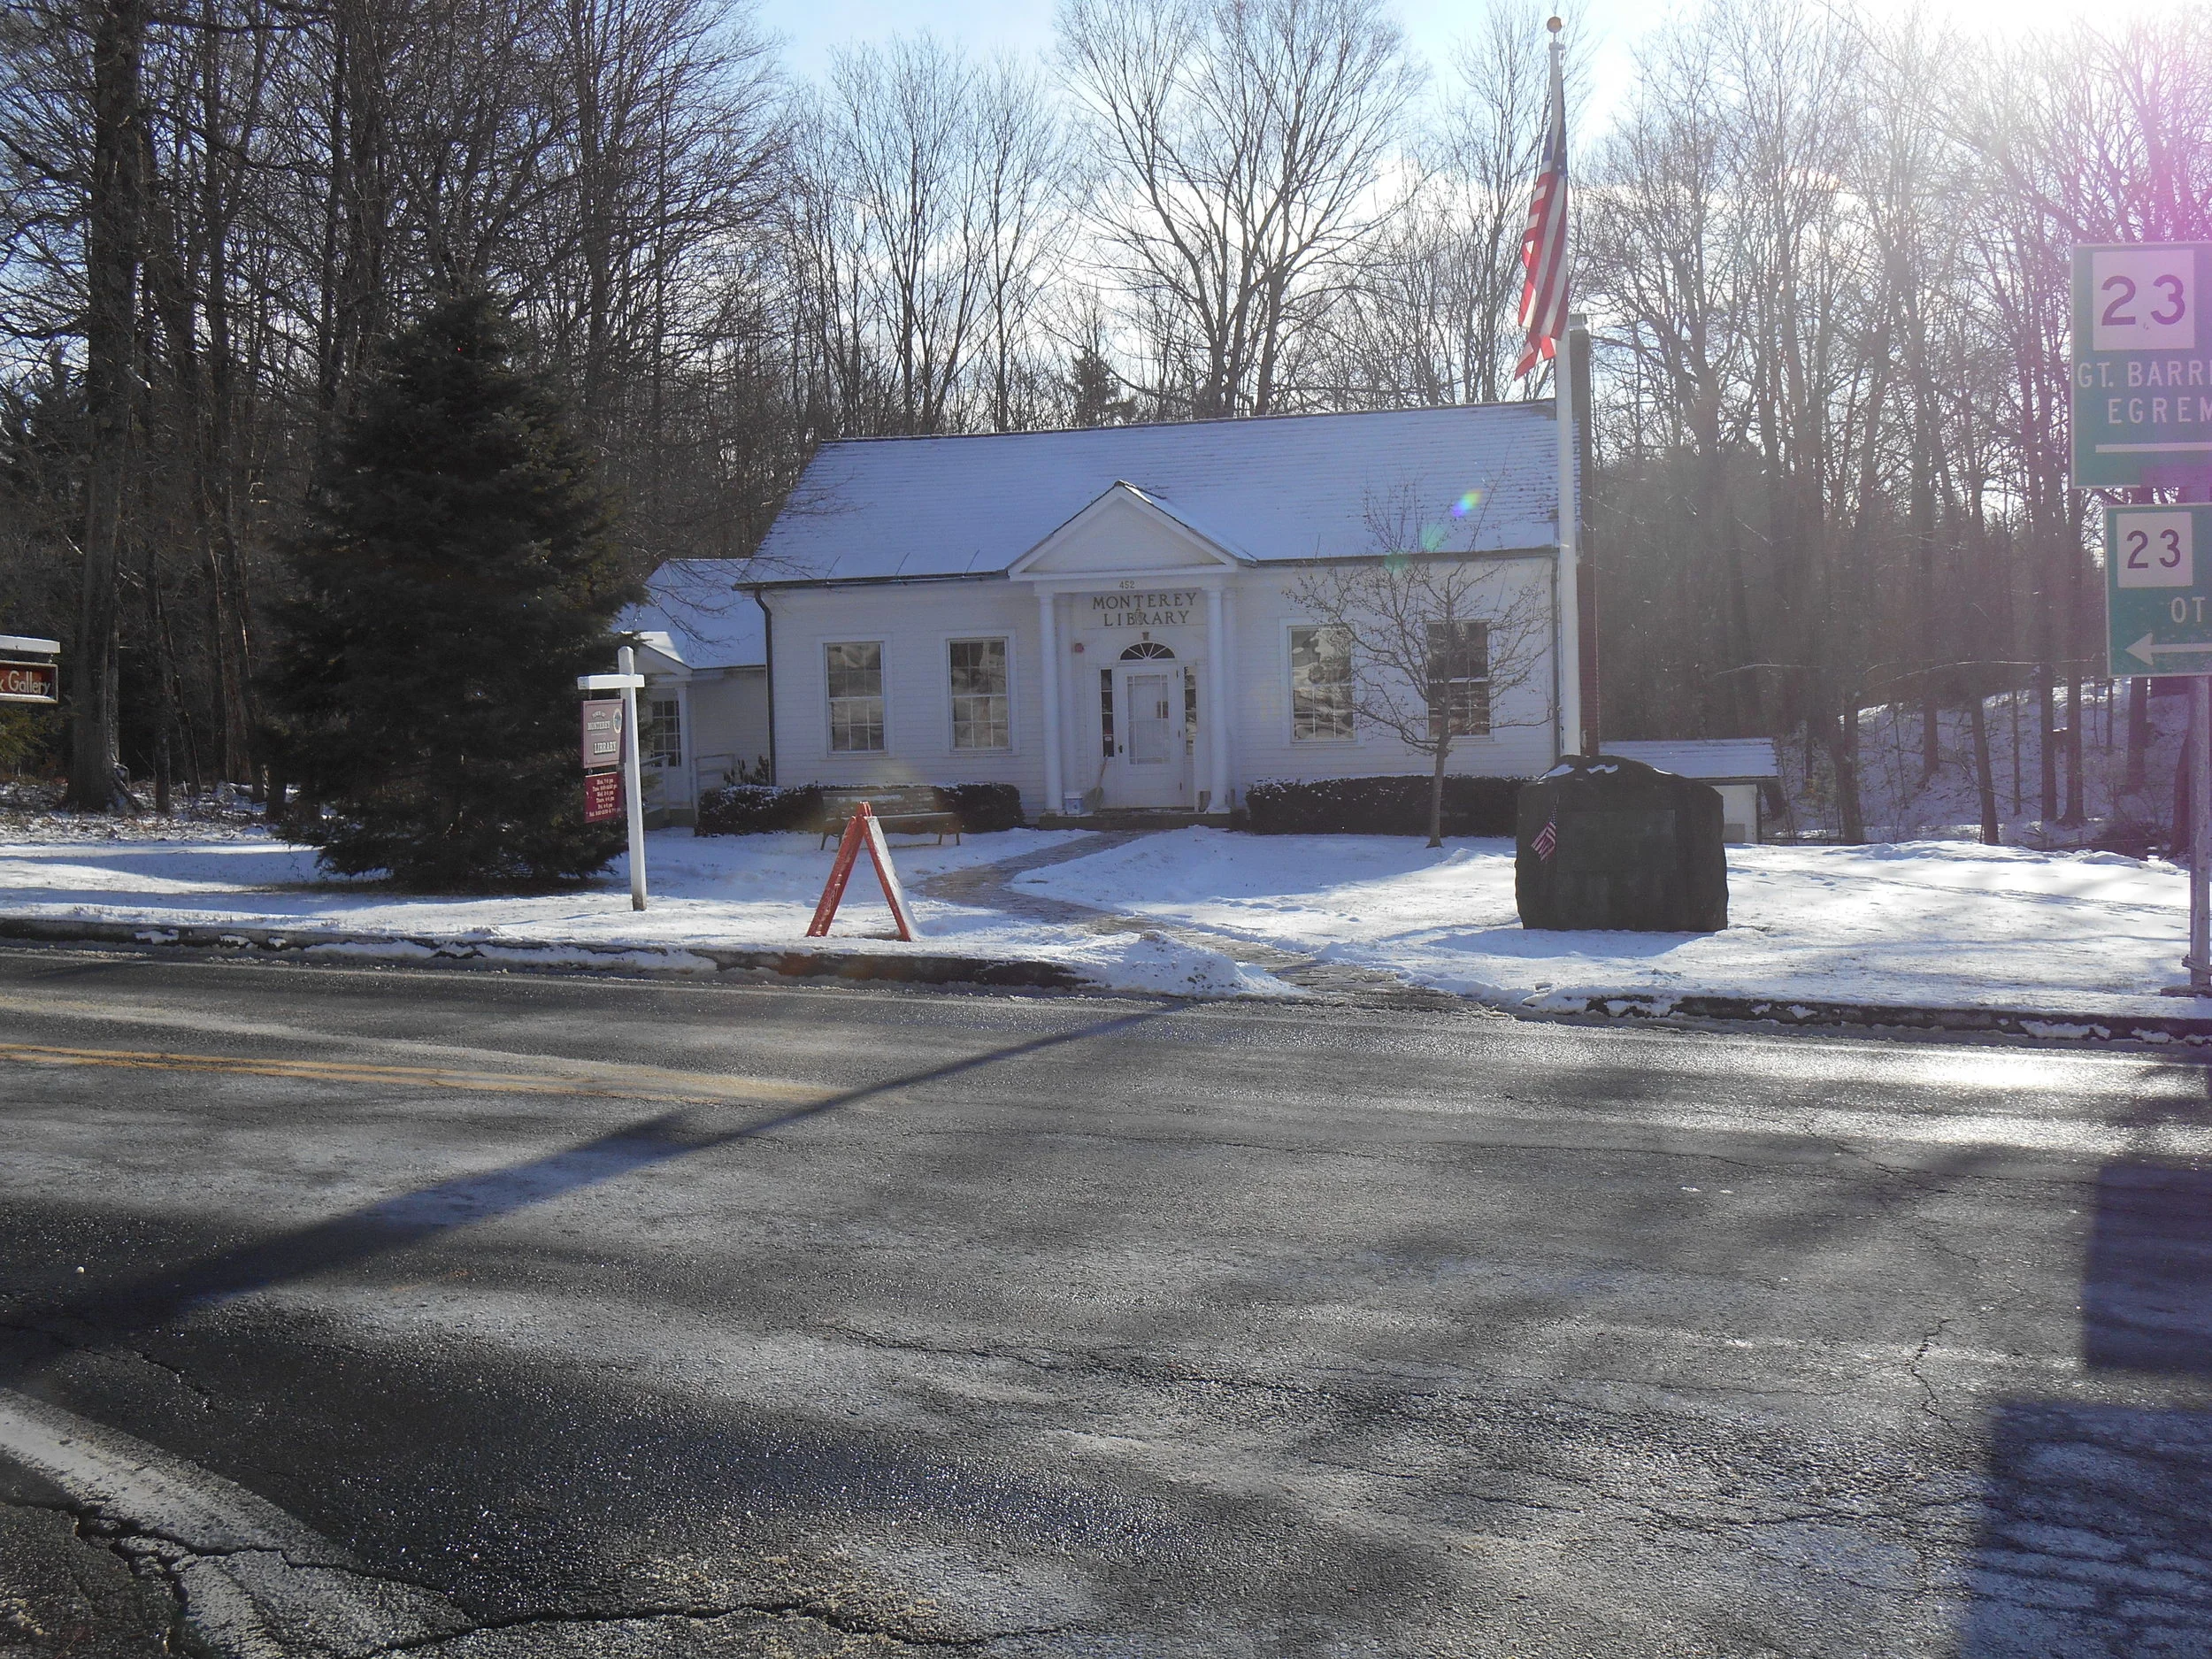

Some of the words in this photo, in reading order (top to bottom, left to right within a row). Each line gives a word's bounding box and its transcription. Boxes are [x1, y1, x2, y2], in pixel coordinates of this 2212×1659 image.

[2101, 274, 2185, 326] 23
[2078, 362, 2114, 388] GT.
[2126, 528, 2181, 569] 23
[1094, 592, 1197, 610] MONTEREY
[1104, 611, 1189, 626] LIBRARY
[9, 671, 50, 695] Gallery
[588, 721, 611, 730] MONTEREY
[595, 741, 616, 753] LIBRARY
